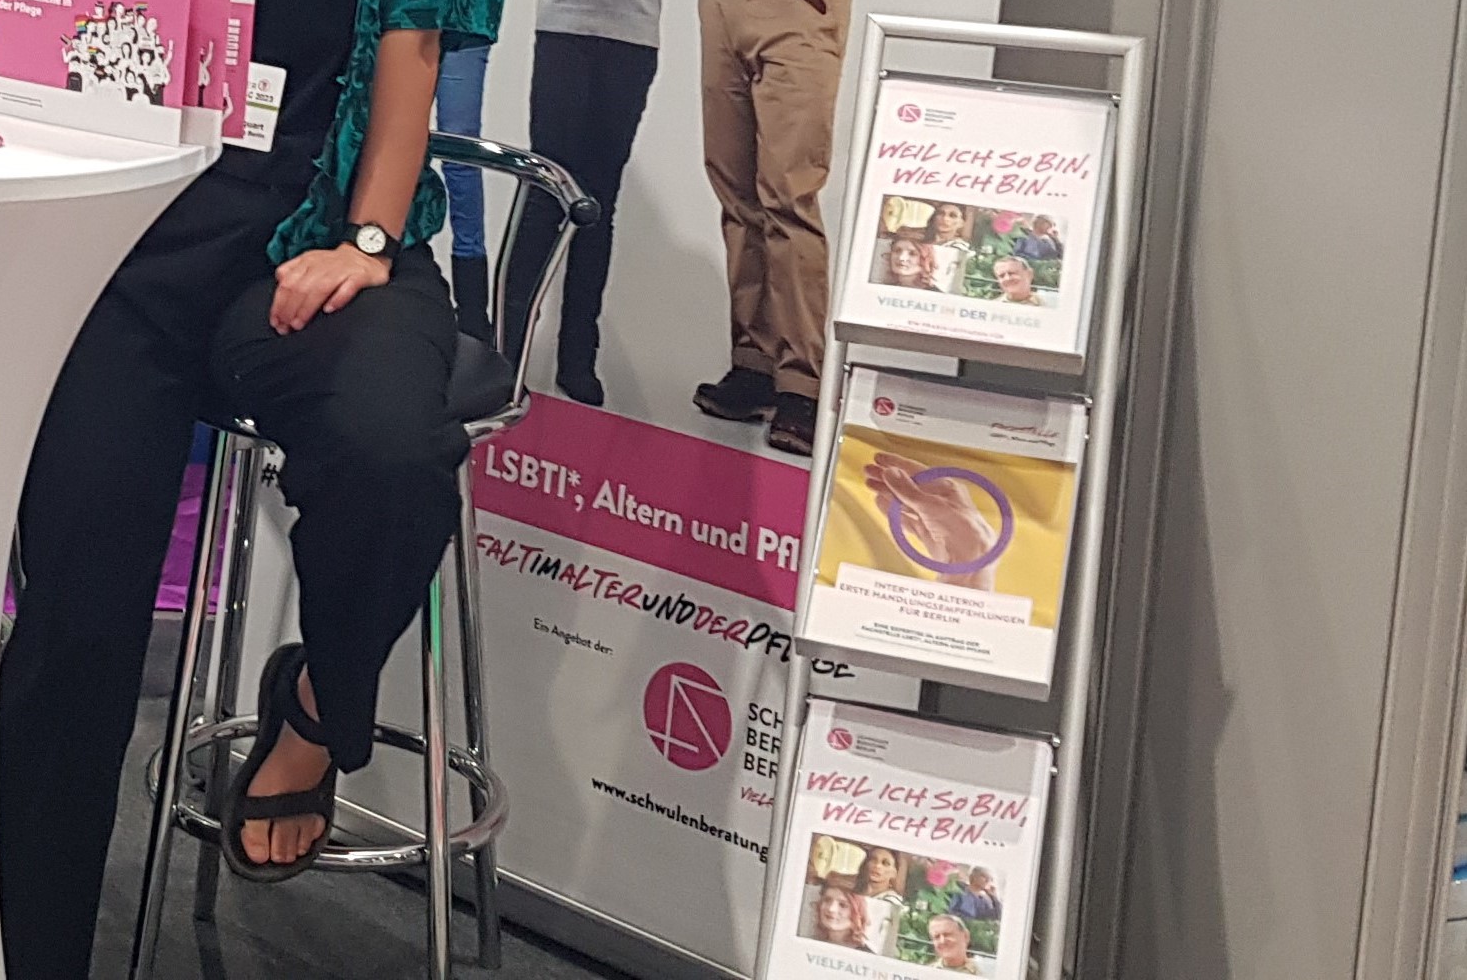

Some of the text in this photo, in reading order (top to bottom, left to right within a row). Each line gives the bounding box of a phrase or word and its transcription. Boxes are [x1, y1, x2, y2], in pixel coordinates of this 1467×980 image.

[878, 141, 1090, 180] WEIL ICH SO BIN,
[893, 166, 941, 185] WIE
[946, 172, 993, 192] ICH
[877, 295, 937, 313] VIELFALT
[959, 308, 988, 321] DER
[592, 479, 683, 536] Altern
[691, 521, 748, 556] und
[551, 626, 593, 649] Angebot
[806, 771, 1028, 827] WEIL ICH SO BIN,
[823, 802, 873, 824] WIE
[879, 812, 928, 838] ICH
[806, 952, 869, 977] VIELFALT
